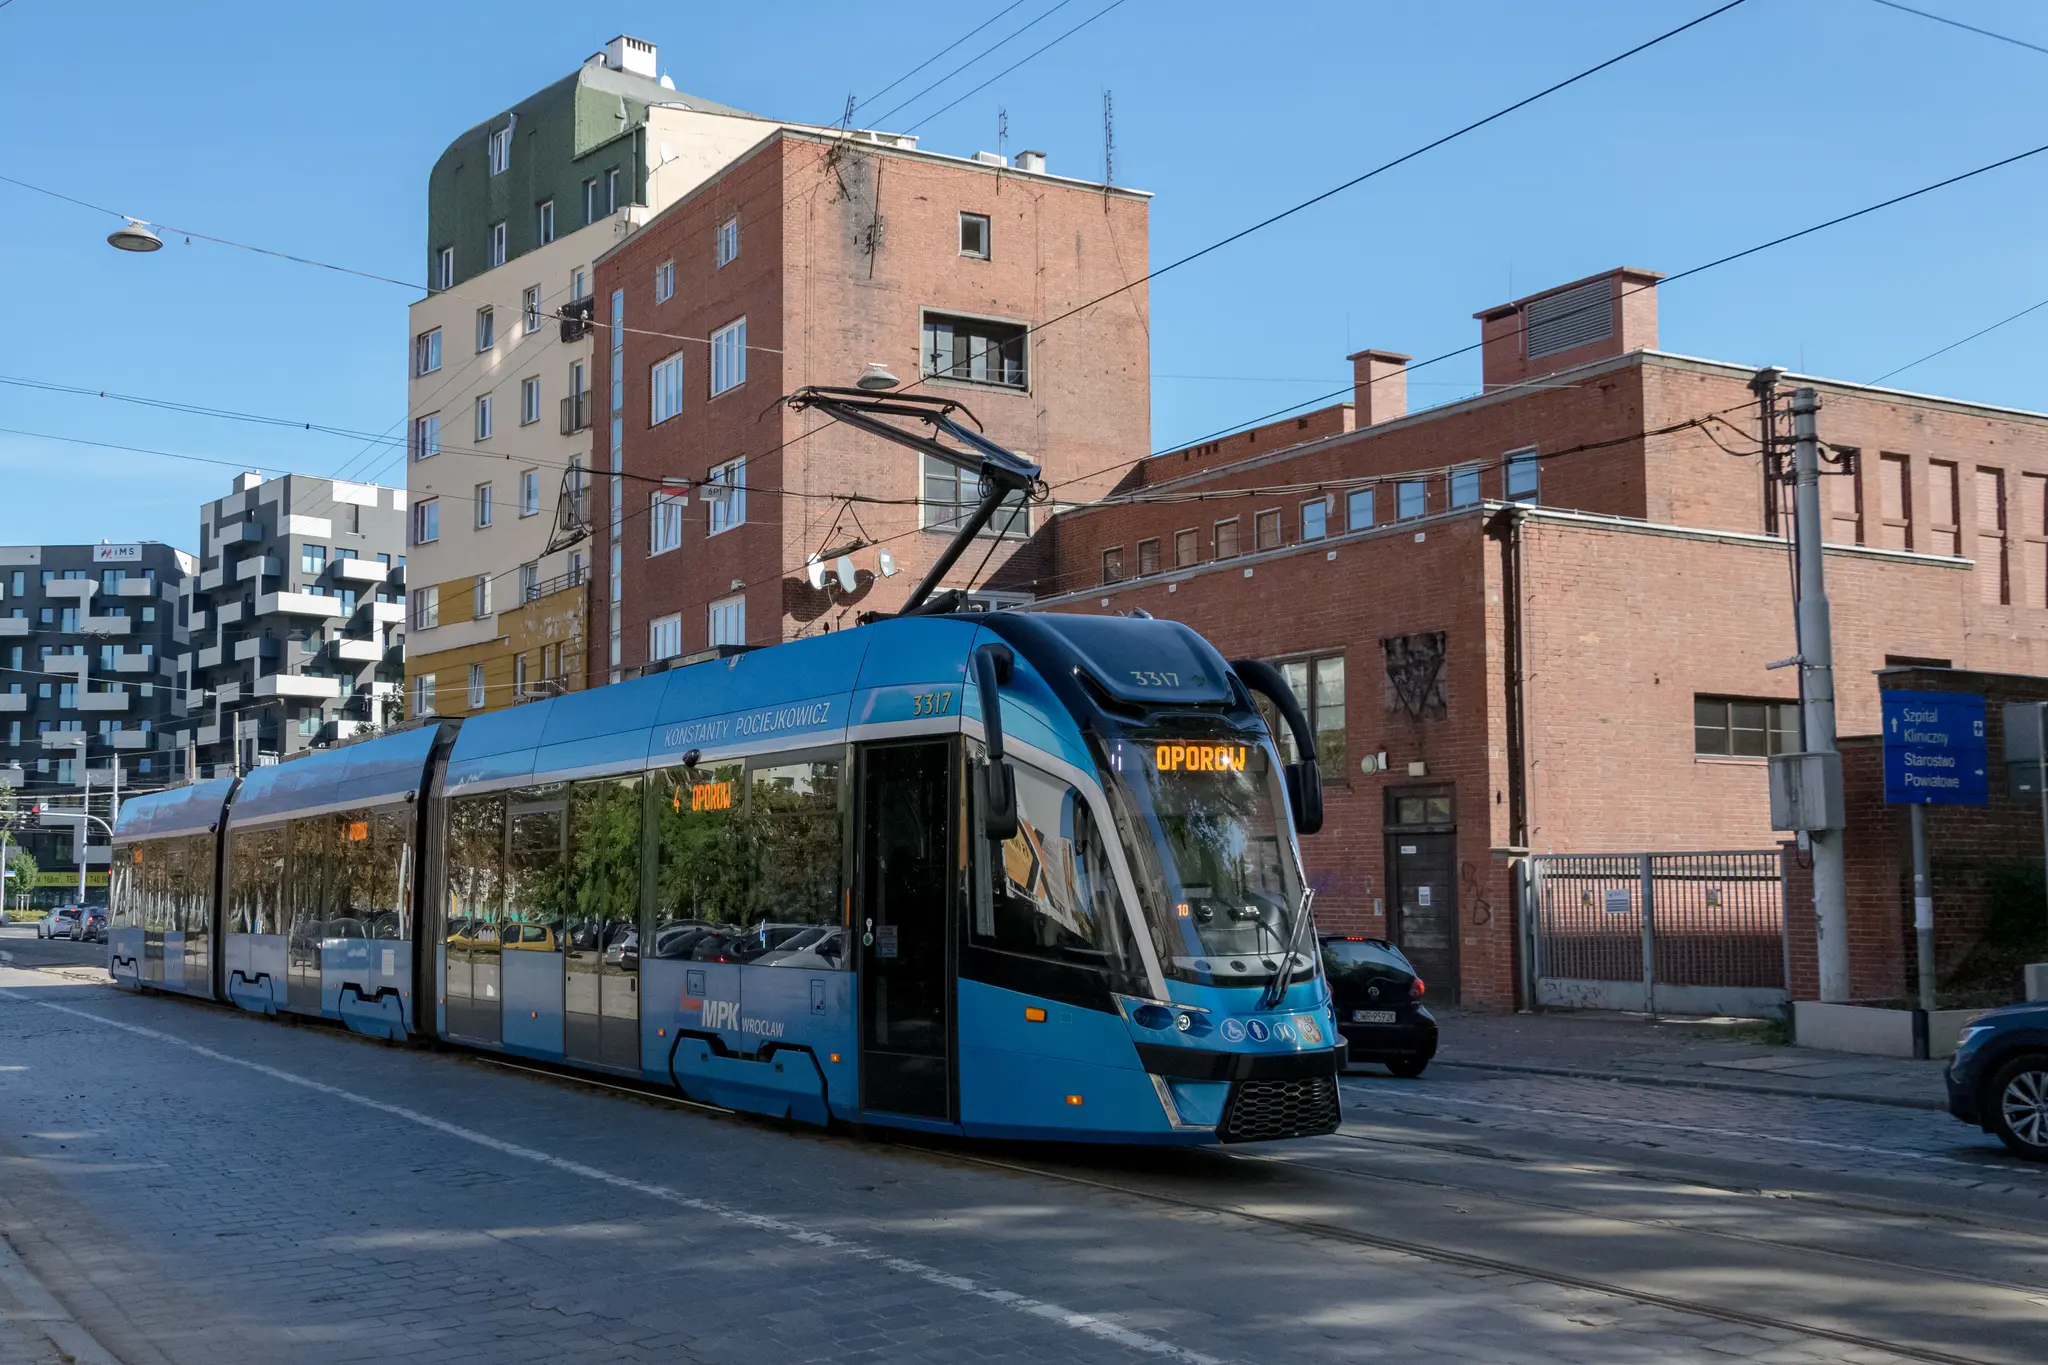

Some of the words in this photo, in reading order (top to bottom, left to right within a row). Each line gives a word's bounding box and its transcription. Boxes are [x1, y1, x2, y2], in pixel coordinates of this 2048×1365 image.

[1130, 670, 1180, 687] 3317
[912, 691, 953, 717] 3317
[664, 718, 731, 747] KONSTANTY
[734, 701, 831, 737] POCIEJKOWICZ
[1903, 708, 1938, 725] Szpital
[1903, 729, 1949, 747] Kliniczny
[1904, 752, 1955, 768] Starostwo
[1904, 772, 1960, 788] Powiatowe
[673, 784, 681, 814] 4
[1176, 903, 1189, 917] 10
[702, 999, 740, 1031] MPK
[741, 1017, 785, 1037] WROCŁAW
